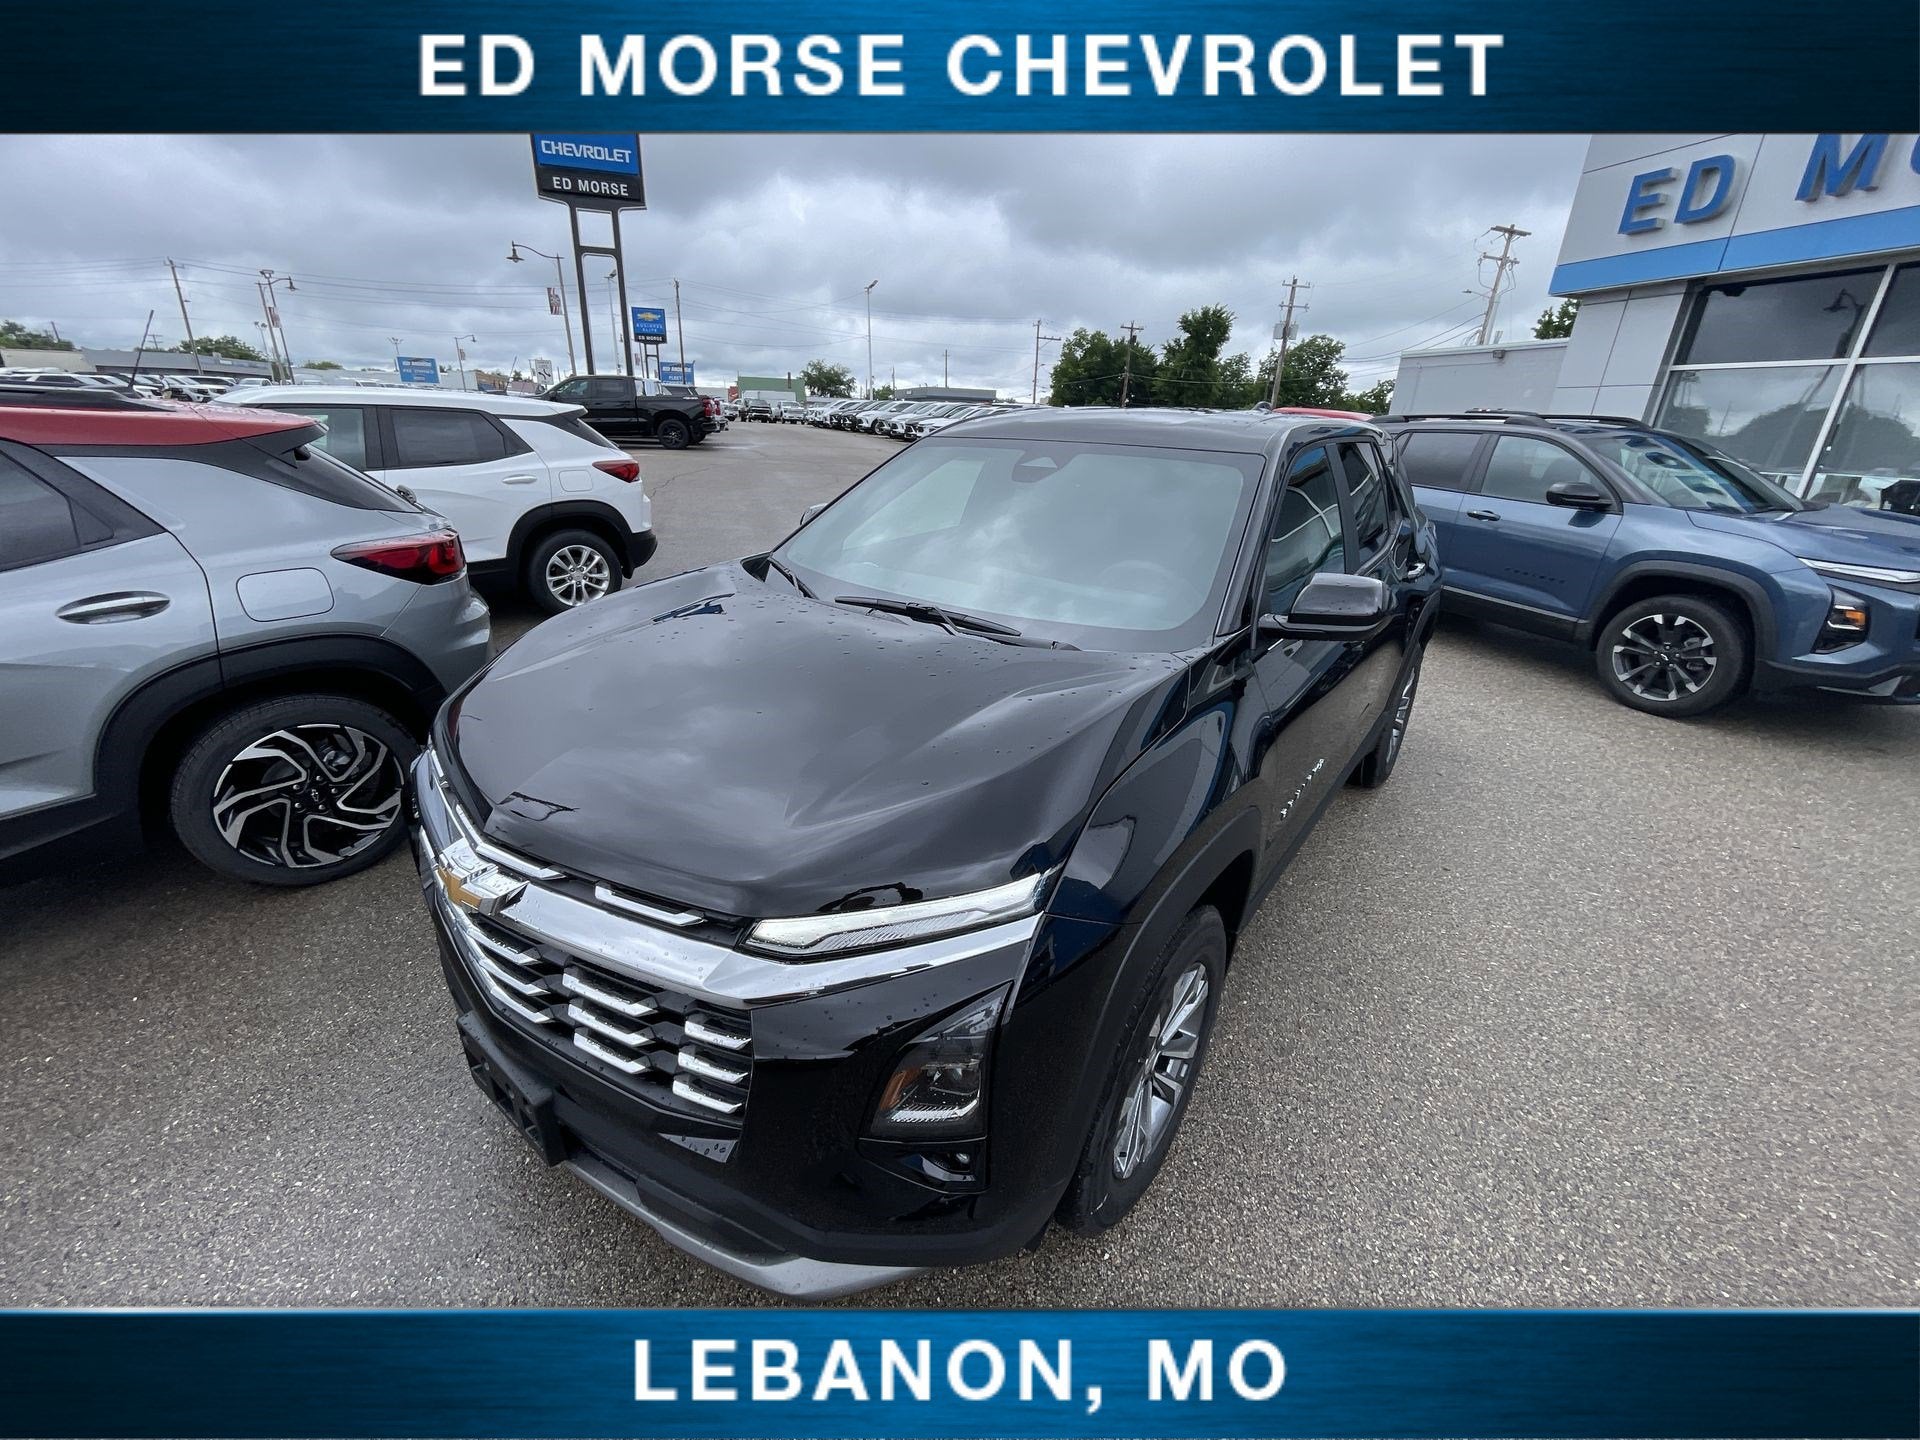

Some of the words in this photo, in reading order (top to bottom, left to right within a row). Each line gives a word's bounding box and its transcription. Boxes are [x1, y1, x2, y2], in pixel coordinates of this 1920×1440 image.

[541, 140, 632, 163] CHEVROLET
[552, 176, 572, 190] ED
[578, 179, 629, 196] MORSE
[1617, 154, 1737, 235] ED
